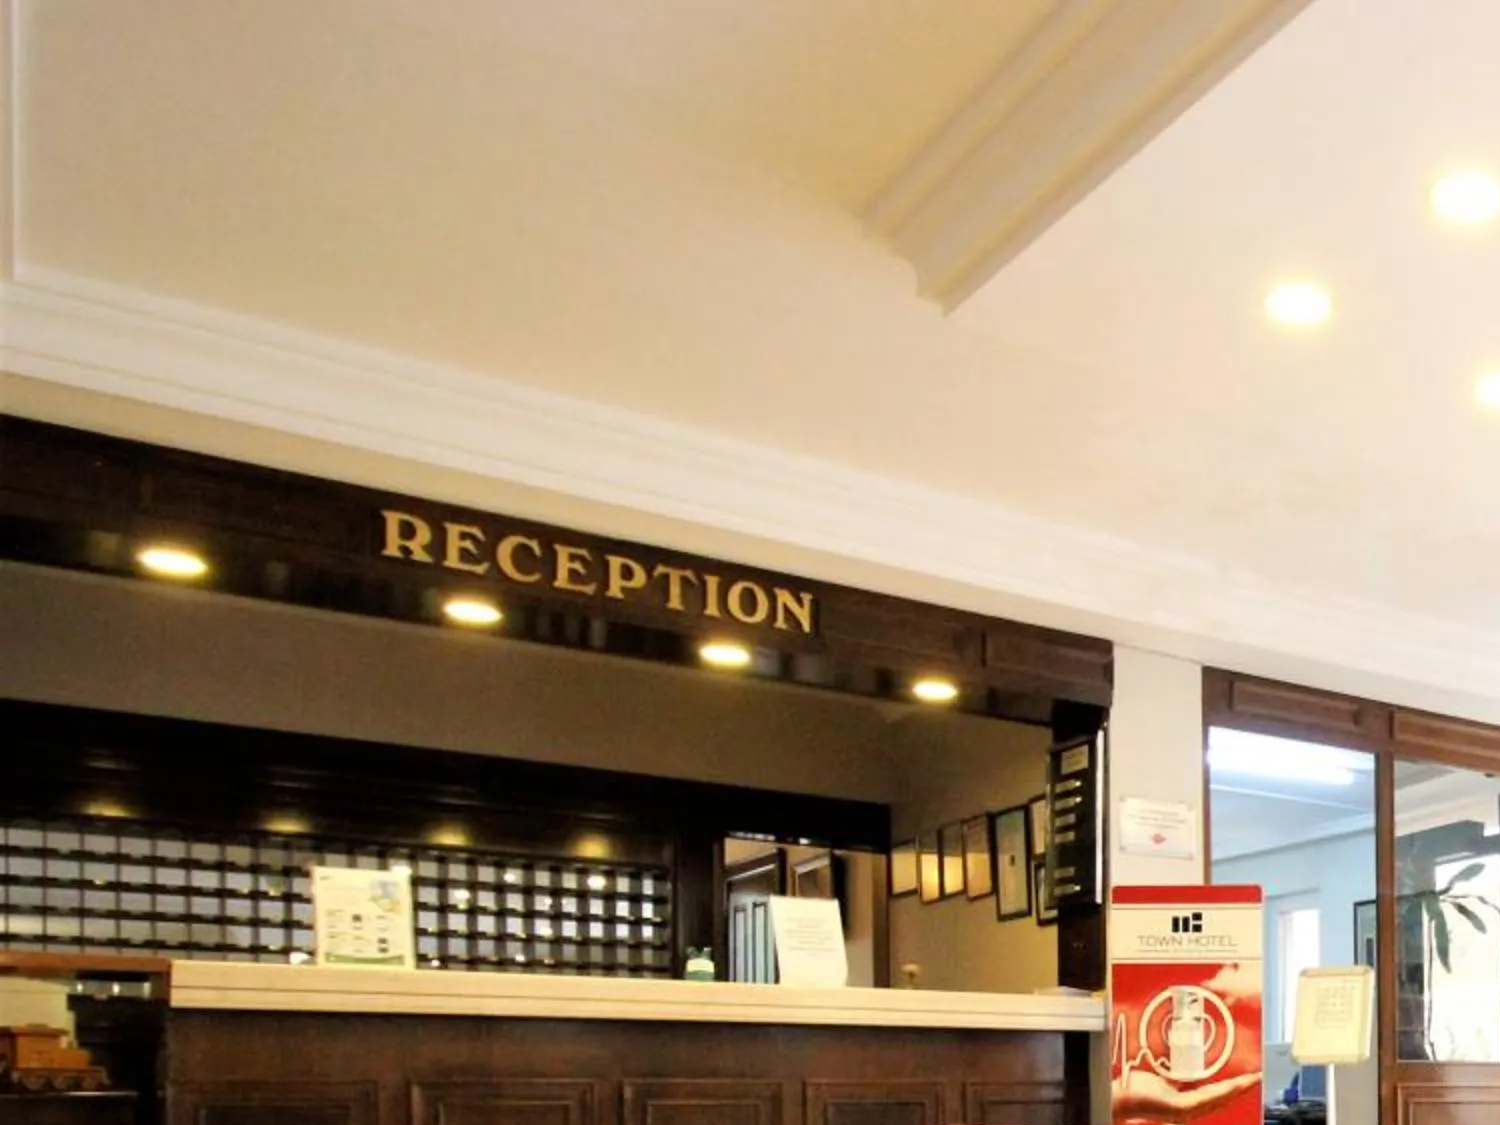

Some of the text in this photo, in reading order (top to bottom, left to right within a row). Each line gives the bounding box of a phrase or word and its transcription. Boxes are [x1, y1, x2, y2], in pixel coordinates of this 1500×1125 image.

[381, 510, 813, 633] RECEPTION
[1136, 934, 1239, 947] TOWN HOTEL
